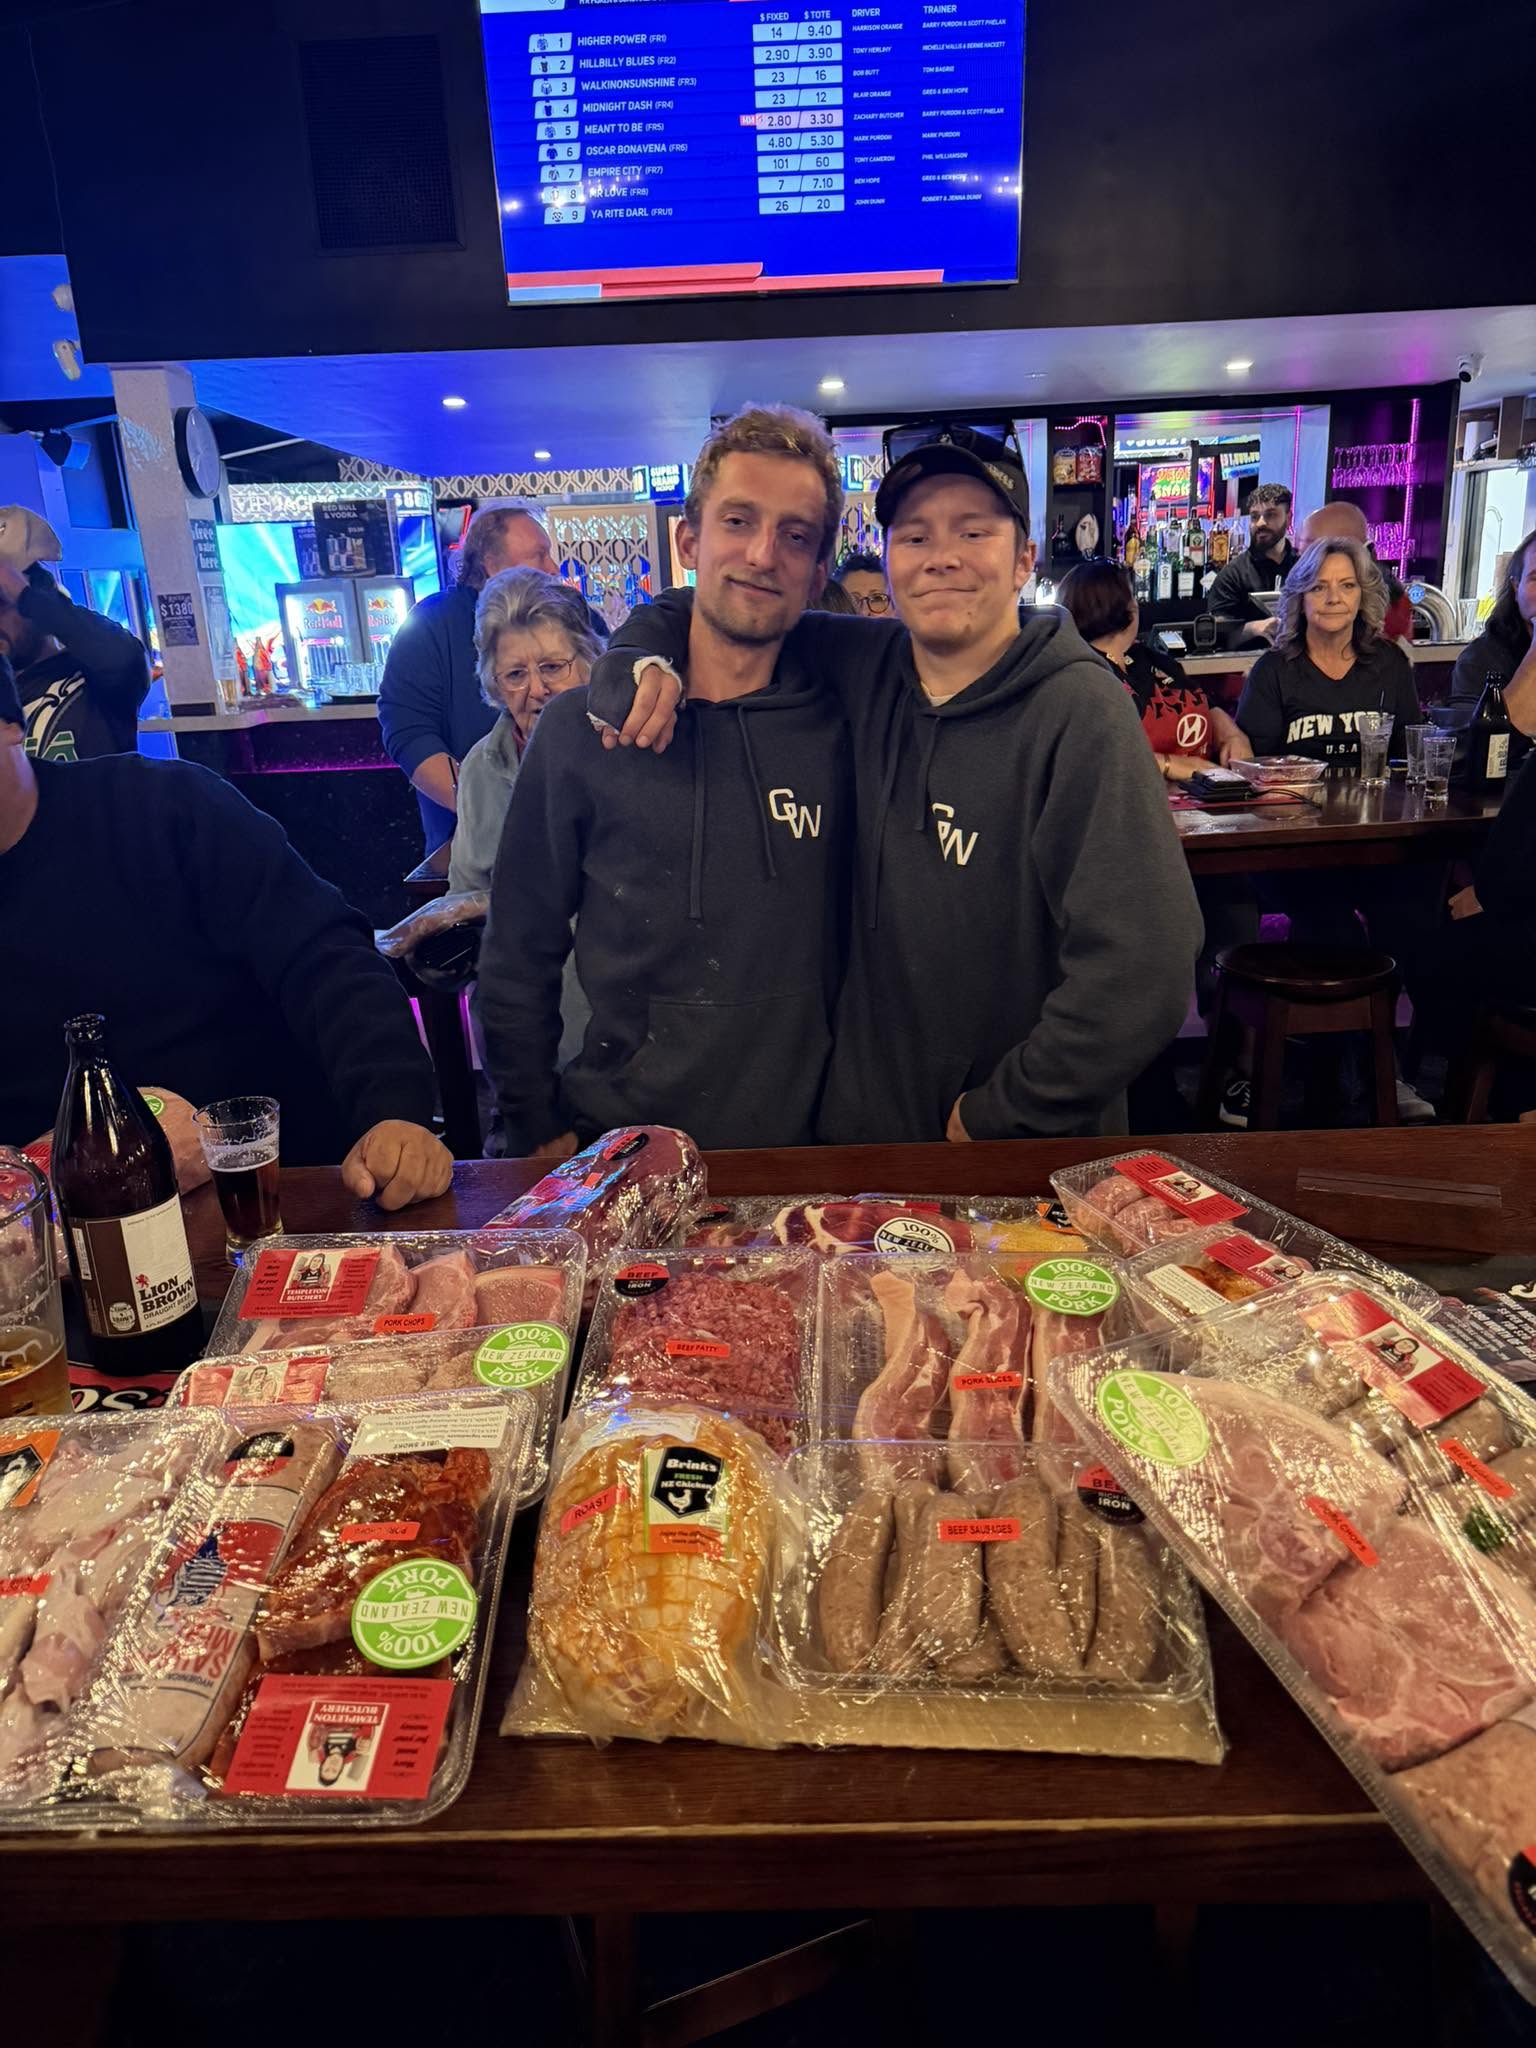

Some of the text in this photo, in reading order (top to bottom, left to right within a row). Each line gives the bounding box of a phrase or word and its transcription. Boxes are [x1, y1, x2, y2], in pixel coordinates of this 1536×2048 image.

[810, 10, 831, 20] TOTE
[852, 8, 880, 17] DRIVER
[924, 4, 957, 14] TRAINER
[766, 12, 789, 22] FIXED
[771, 27, 782, 38] 14
[808, 25, 832, 36] 9.40
[578, 36, 612, 46] HIGHER
[614, 34, 647, 44] POWER
[766, 50, 790, 60] 2.90
[808, 48, 832, 59] 3.90
[580, 58, 624, 68] HILLBILLY
[626, 56, 654, 66] BLUES
[772, 72, 785, 82] 23
[816, 70, 826, 81] 16
[581, 78, 675, 90] WALKINONSUNSHINE
[772, 94, 786, 104] 23
[816, 92, 826, 103] 12
[583, 102, 626, 112] MIDNIGHT
[628, 100, 652, 110] DASH
[768, 116, 792, 127] 2.80
[810, 113, 834, 124] 3.30
[584, 124, 616, 134] MEANT
[617, 123, 630, 132] TO
[631, 122, 643, 132] BE
[768, 136, 792, 148] 4.80
[810, 134, 834, 146] 5.30
[586, 145, 616, 156] OSCAR
[618, 144, 666, 154] BONAVENA
[774, 158, 788, 170] 101
[816, 156, 830, 168] 60
[588, 167, 620, 177] EMPIRE
[622, 166, 642, 176] CITY
[778, 180, 784, 190] 7
[812, 178, 834, 188] 7.10
[606, 186, 628, 197] LOVE
[776, 200, 790, 212] 26
[817, 198, 830, 210] 20
[592, 210, 604, 218] YA
[605, 208, 624, 218] RITE
[626, 208, 648, 217] DARL
[322, 504, 338, 512] RED
[160, 602, 193, 616] $1380
[1286, 714, 1334, 744] NEW
[768, 788, 822, 838] GW
[880, 1230, 901, 1245] NEW
[902, 1222, 940, 1244] 100%
[1048, 1262, 1096, 1278] 100%
[139, 1275, 178, 1301] LION
[1031, 1276, 1114, 1293] NEW ZEALAND
[140, 1276, 194, 1314] BROWN
[1046, 1292, 1102, 1311] PORK
[144, 1302, 177, 1320] DRAUGHT
[384, 1318, 425, 1328] PORK CHOPS
[505, 1328, 552, 1344] 100%
[480, 1350, 562, 1360] NEW ZEALAND
[488, 1366, 544, 1384] PORK
[962, 1378, 984, 1386] PORK
[666, 1458, 717, 1472] Brink's
[676, 1481, 714, 1490] Chicken
[574, 1494, 609, 1519] ROAST
[1098, 1498, 1130, 1511] IRON
[948, 1524, 1013, 1535] BEEF SAUSAGES
[1340, 1522, 1366, 1552] CHOPS
[381, 1567, 454, 1594] PORK
[360, 1600, 469, 1620] NEW ZEALAND
[377, 1630, 442, 1656] 100%
[320, 1704, 378, 1714] BUTCHERY
[313, 1713, 380, 1724] TEMPLETON
